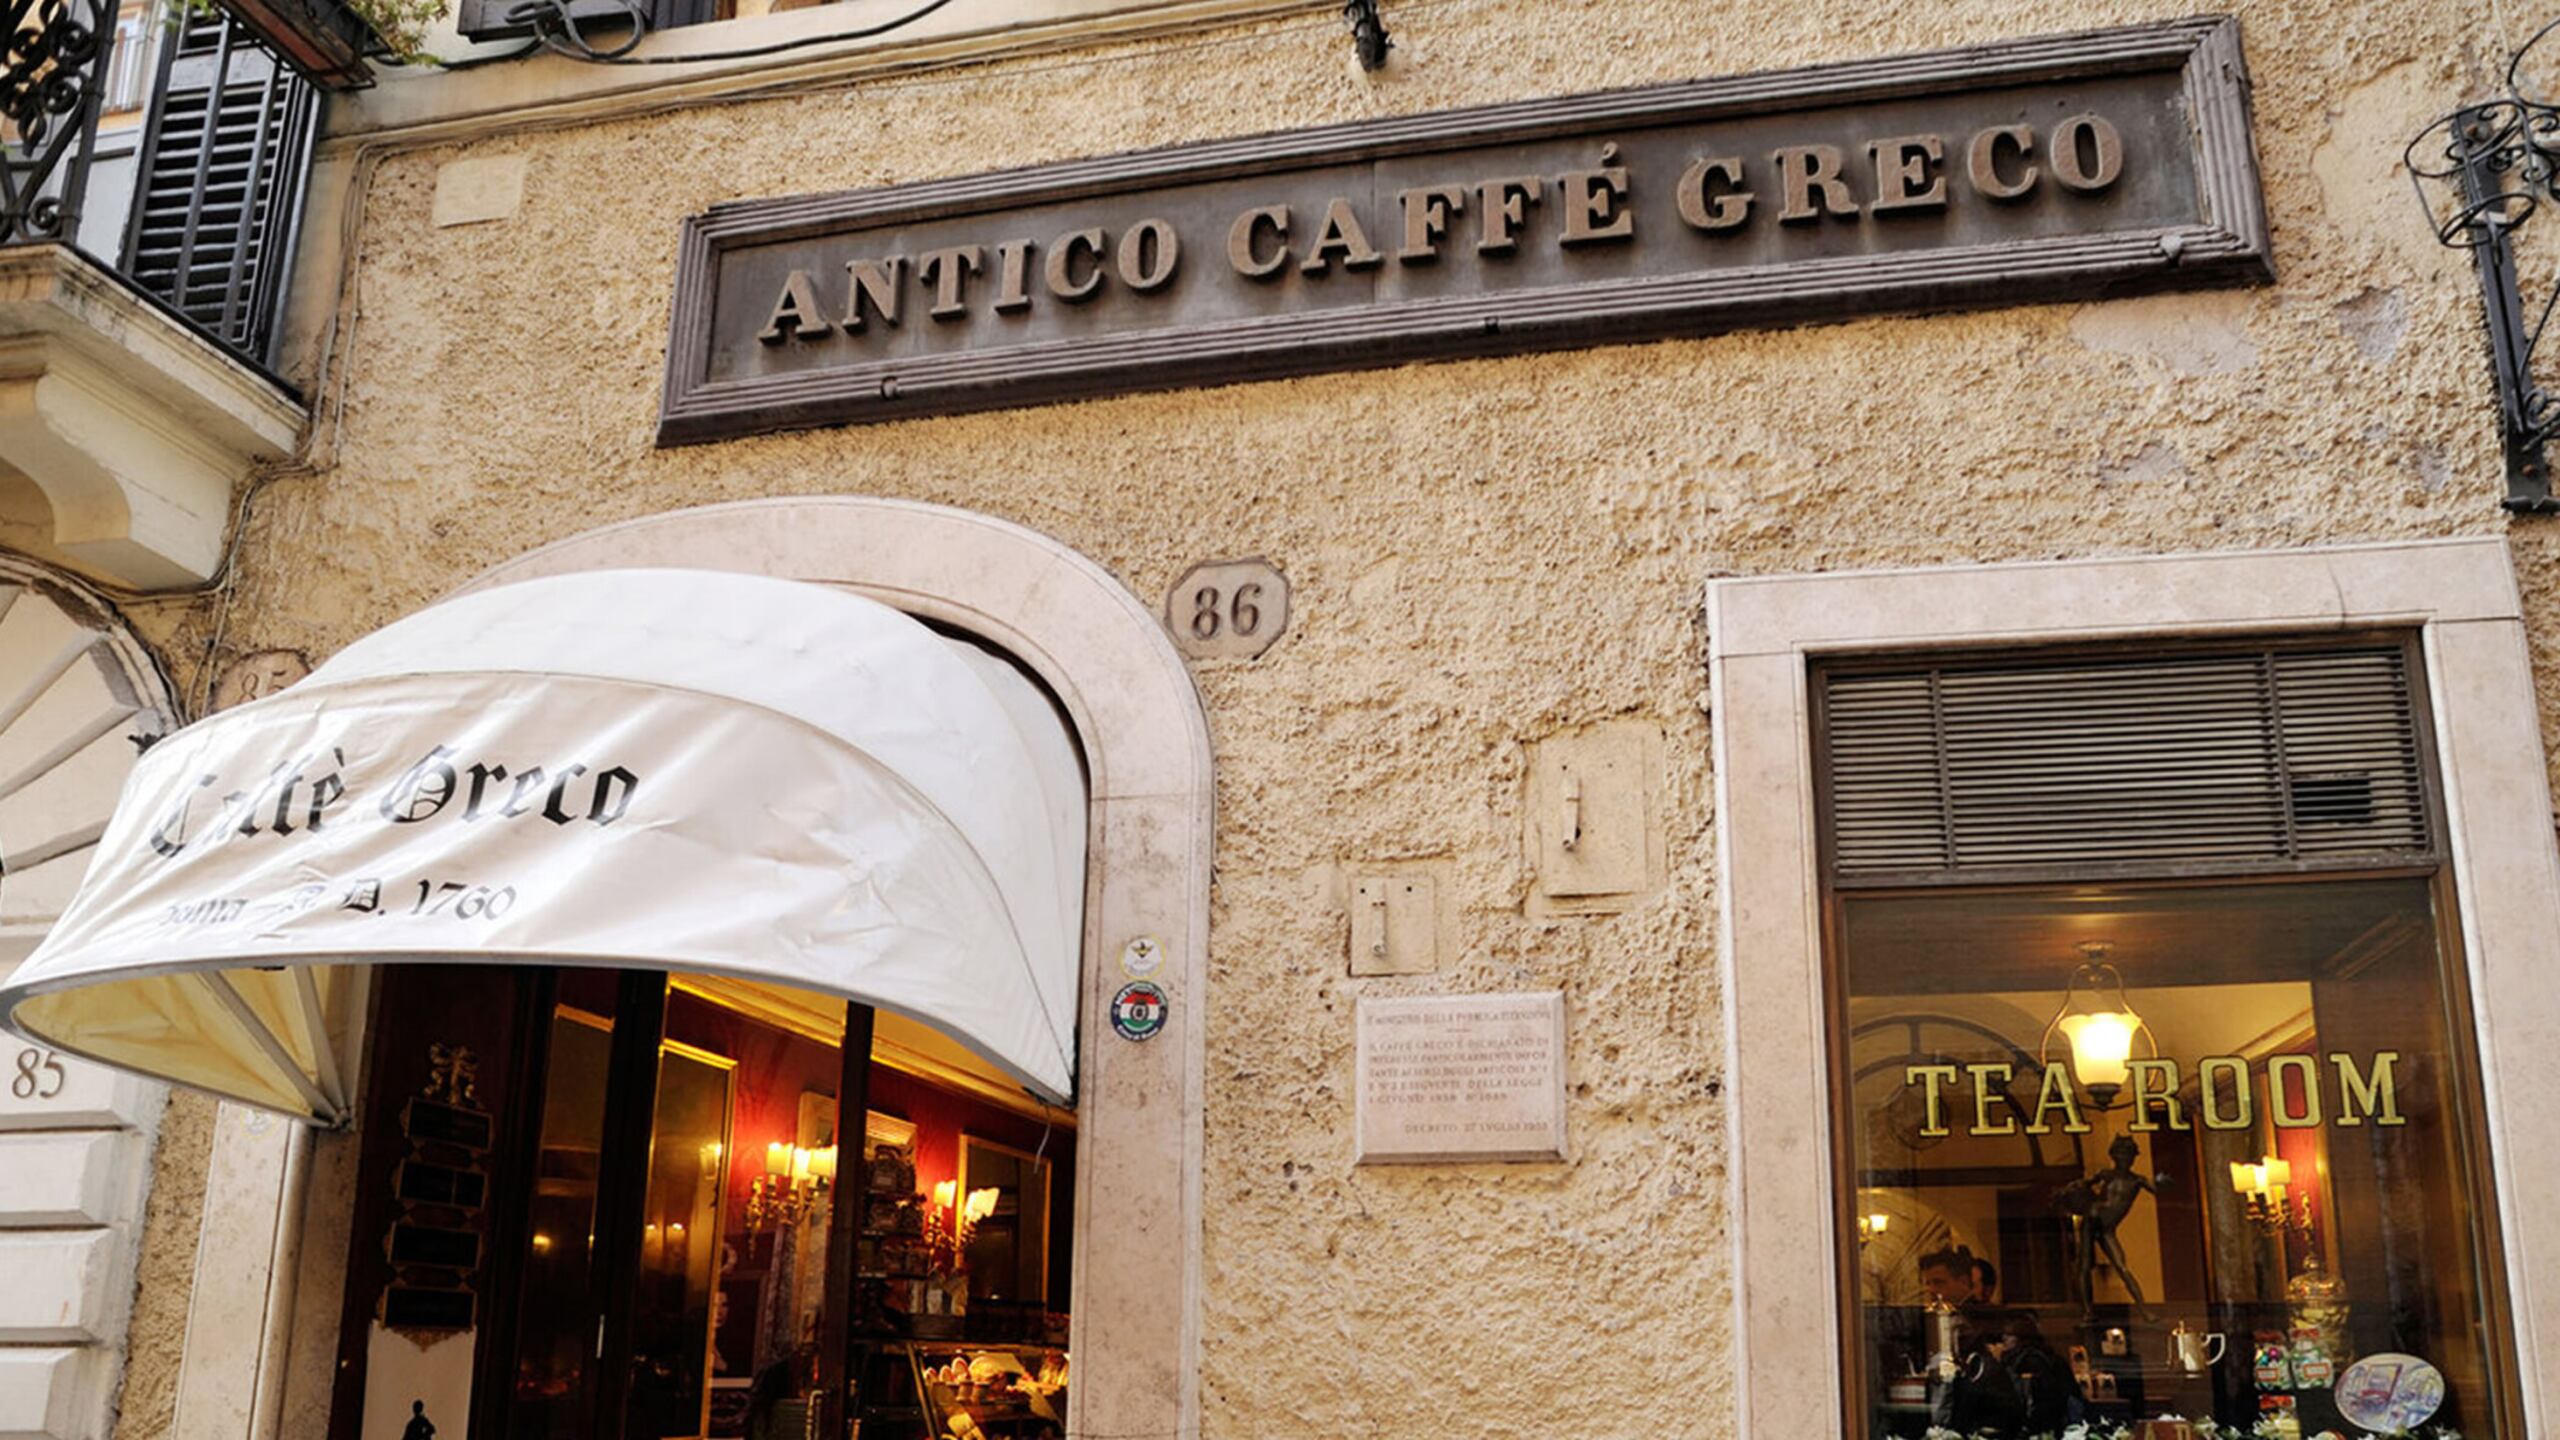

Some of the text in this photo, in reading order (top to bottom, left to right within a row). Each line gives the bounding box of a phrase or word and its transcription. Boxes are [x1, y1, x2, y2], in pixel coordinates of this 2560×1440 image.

[758, 112, 2125, 346] ANTICO CAFFÉ GRECO
[1192, 582, 1261, 641] 86
[379, 743, 640, 827] Greco
[410, 879, 518, 921] 1760
[12, 1048, 64, 1098] 85
[1906, 1052, 2406, 1136] TEA ROOM
